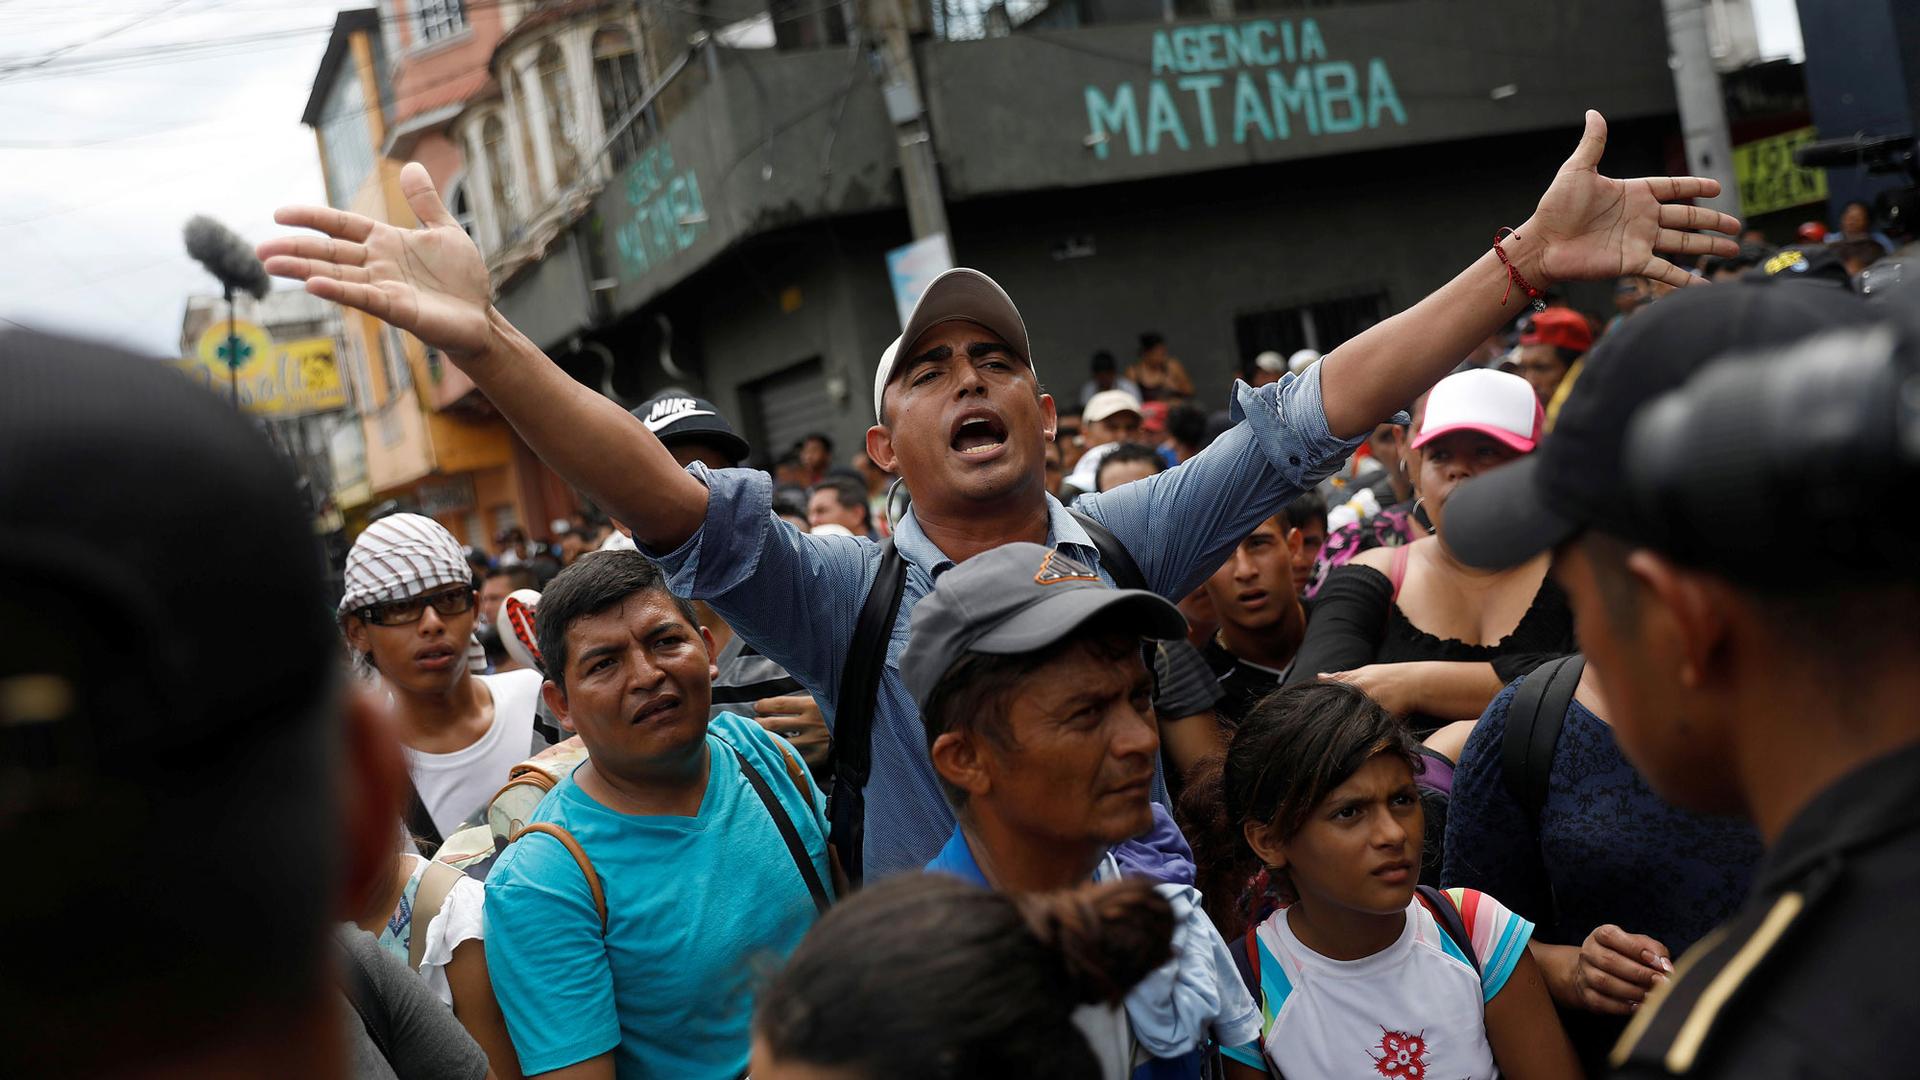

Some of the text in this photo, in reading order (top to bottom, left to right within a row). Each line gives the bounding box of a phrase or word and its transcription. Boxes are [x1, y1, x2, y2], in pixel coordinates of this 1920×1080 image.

[1152, 18, 1327, 76] AGENCIA
[1084, 57, 1408, 160] MATAMBA
[651, 398, 697, 421] NIKE
